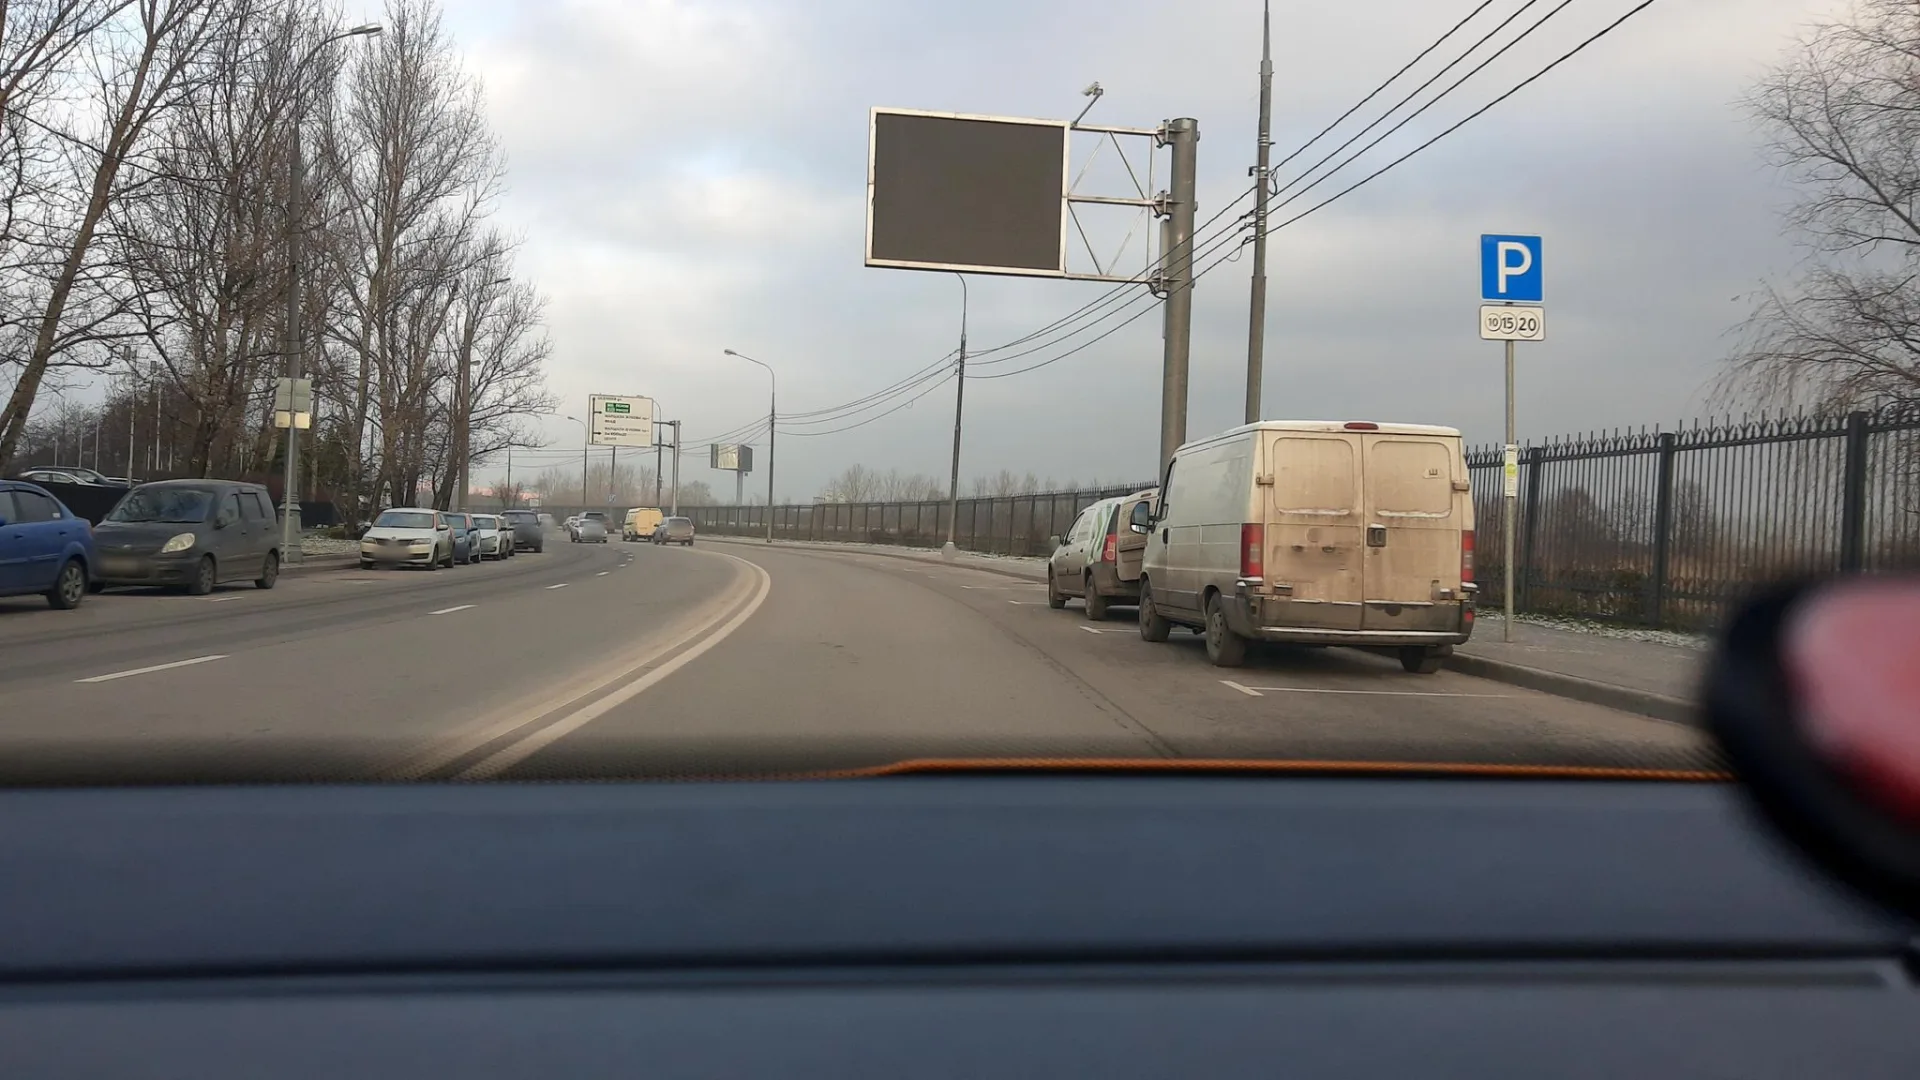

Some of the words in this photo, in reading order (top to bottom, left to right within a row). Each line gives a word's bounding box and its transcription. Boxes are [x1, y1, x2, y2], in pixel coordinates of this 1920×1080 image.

[1498, 241, 1532, 293] P
[1488, 317, 1499, 327] 10
[1501, 317, 1514, 329] 15
[1518, 317, 1537, 331] 20
